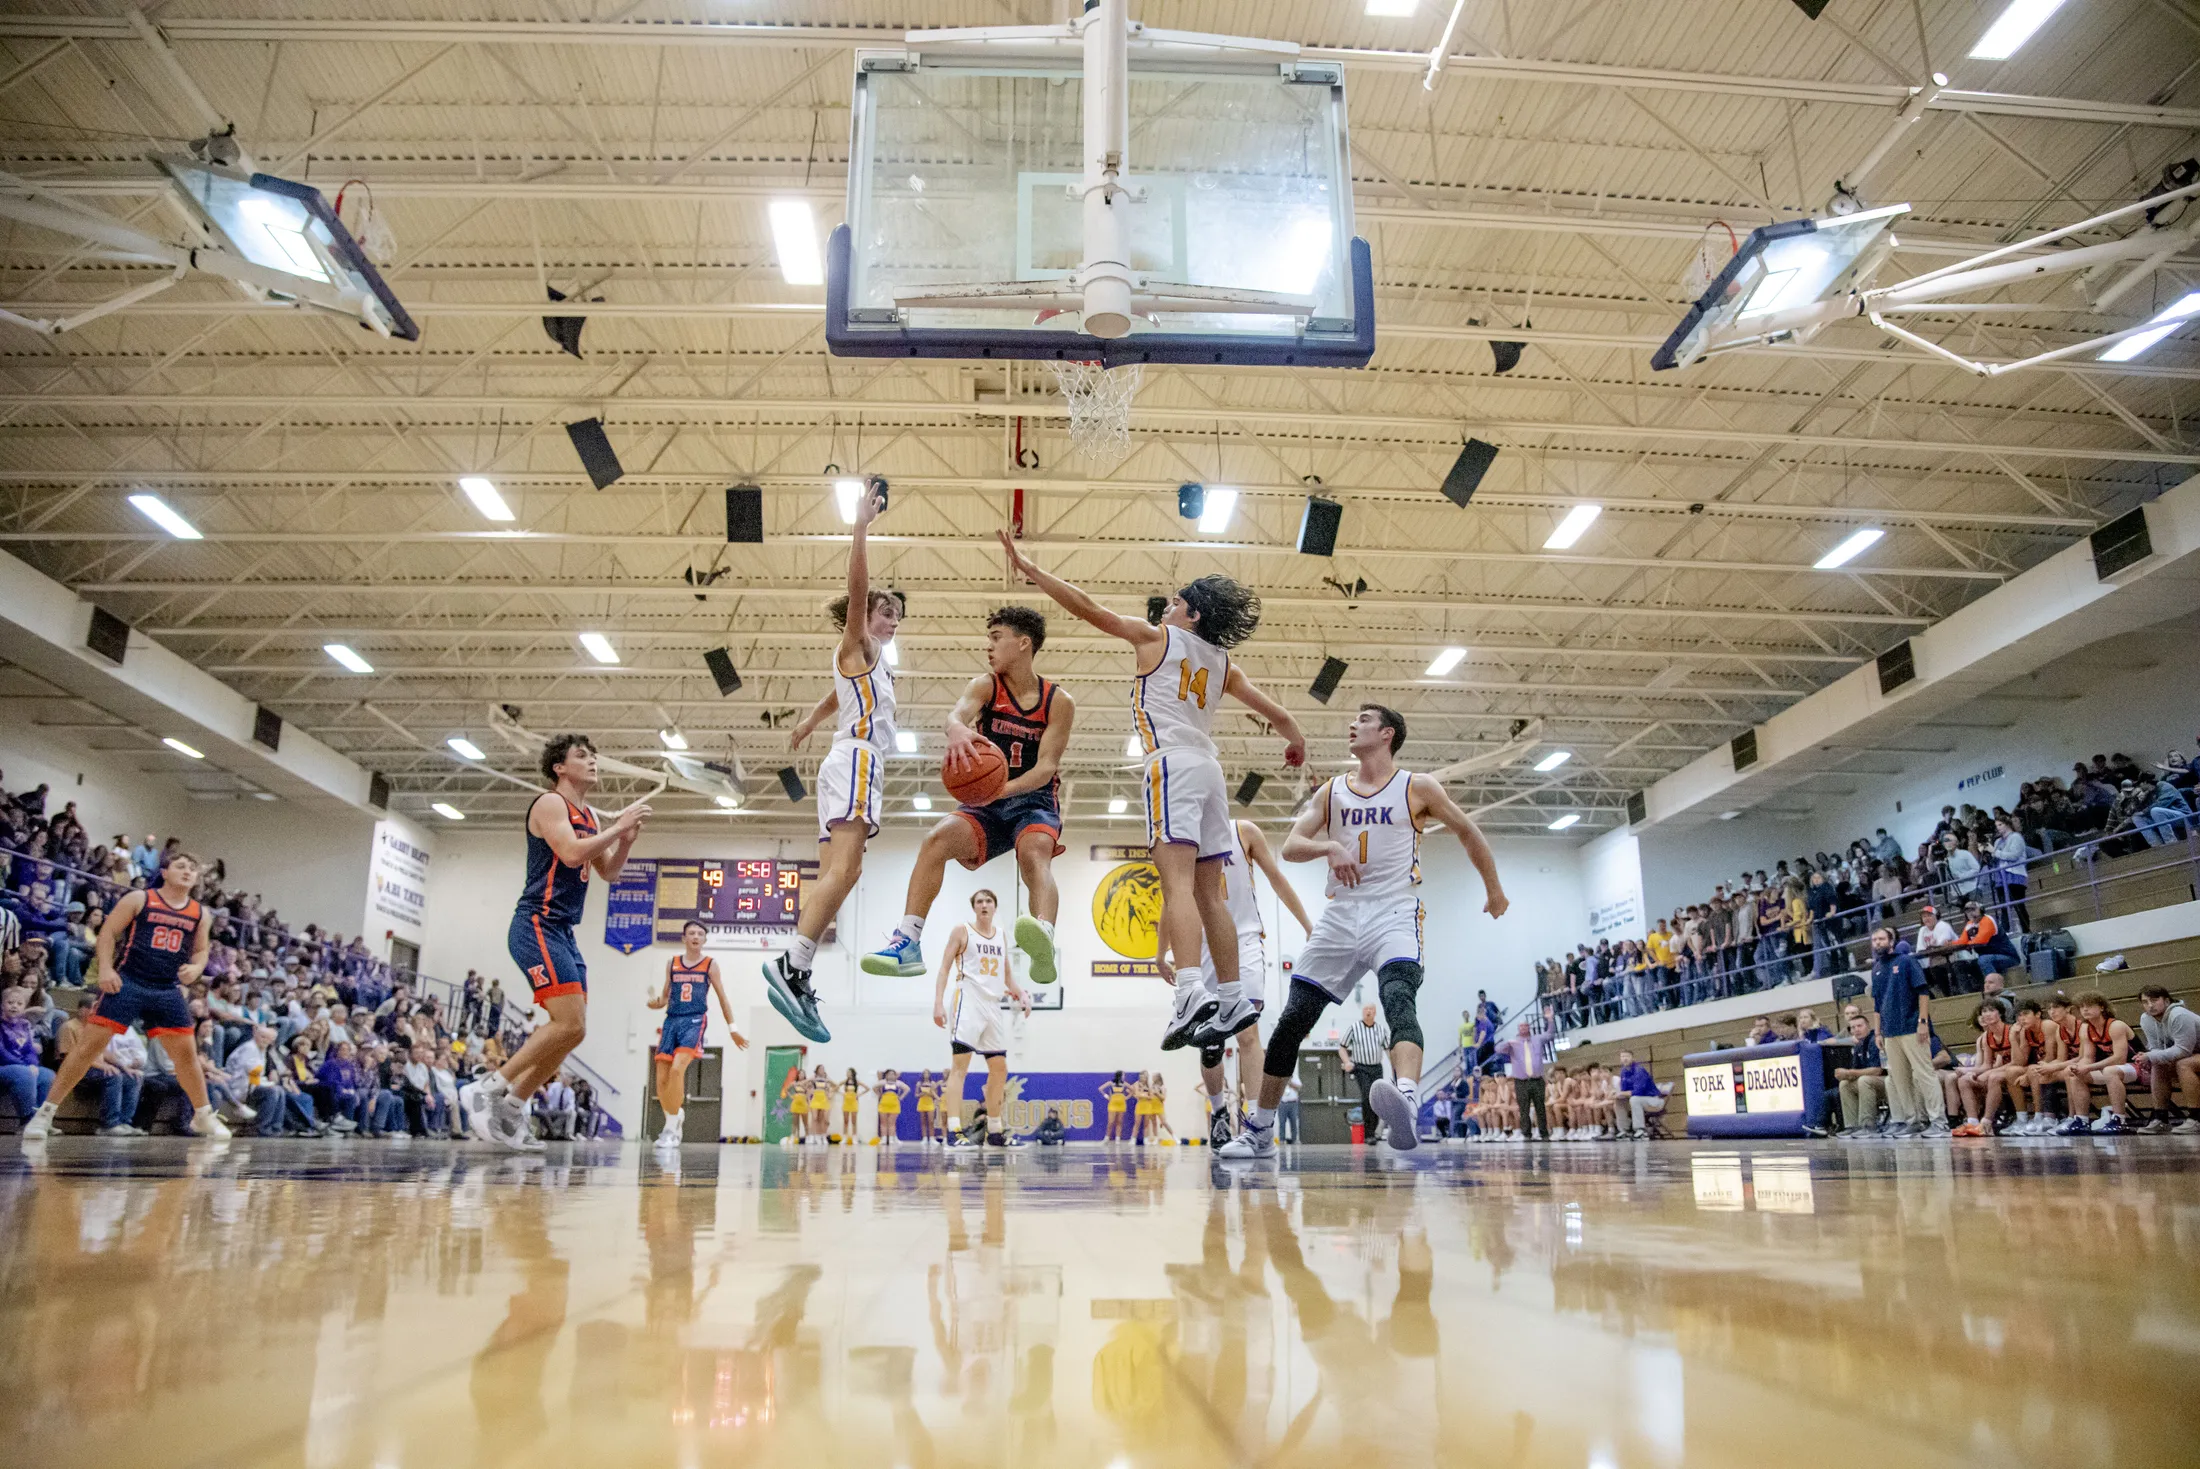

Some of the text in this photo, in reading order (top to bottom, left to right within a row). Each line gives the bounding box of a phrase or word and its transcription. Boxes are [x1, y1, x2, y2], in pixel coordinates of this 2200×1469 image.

[1178, 658, 1209, 710] 14
[991, 718, 1043, 742] KINGSTO
[1009, 741, 1023, 768] 1
[1982, 765, 2004, 781] CLUB
[1341, 807, 1394, 827] YORK
[1358, 830, 1369, 864] 1
[738, 861, 771, 878] 5:58
[703, 870, 799, 889] 49 30
[738, 884, 773, 897] period 3
[708, 897, 715, 909] 1
[785, 898, 794, 911] 0
[736, 911, 758, 920] player
[151, 925, 184, 953] 20
[723, 924, 794, 936] DRAGONS!
[976, 943, 1003, 957] YORK
[528, 964, 550, 987] K
[980, 956, 999, 977] 32
[1094, 964, 1118, 974] HOME
[1119, 964, 1131, 974] OF
[1133, 964, 1149, 974] THE
[680, 982, 693, 1002] 2
[1692, 1074, 1726, 1093] YORK
[1746, 1065, 1799, 1091] DRAGONS
